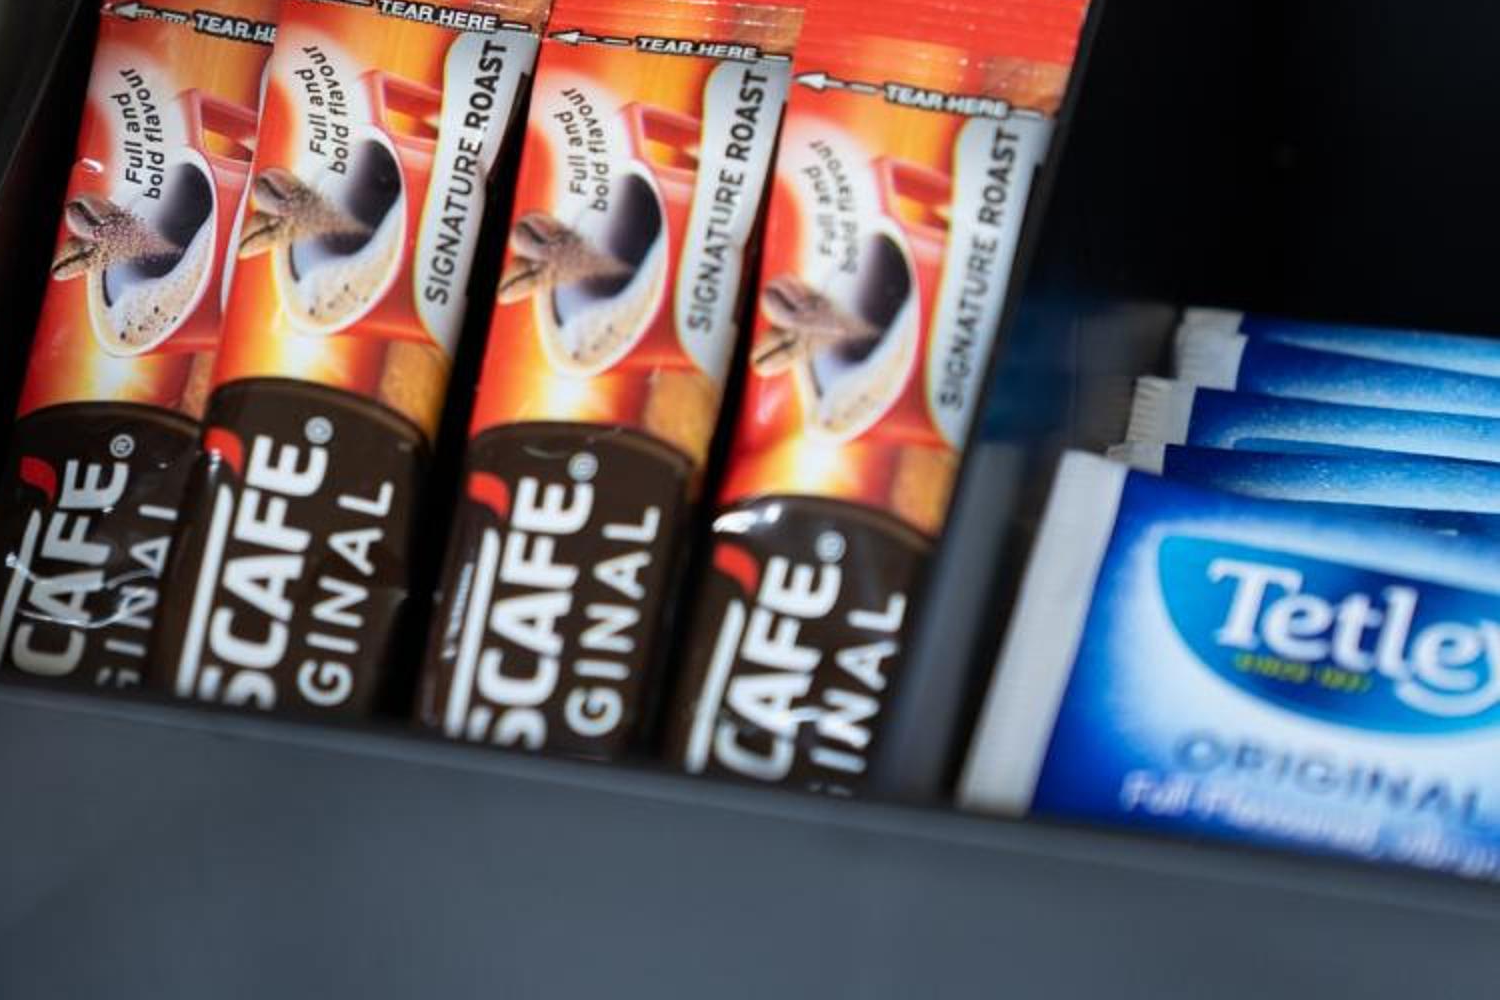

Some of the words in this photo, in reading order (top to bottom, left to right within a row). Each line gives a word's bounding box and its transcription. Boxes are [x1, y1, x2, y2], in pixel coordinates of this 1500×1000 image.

[195, 12, 249, 38] TEAR
[440, 9, 497, 32] HERE
[638, 37, 693, 56] TEAR
[698, 43, 757, 61] HERE
[119, 68, 163, 143] flavour
[294, 69, 324, 109] and
[302, 45, 347, 118] flavour
[887, 84, 942, 109] TEAR
[947, 96, 1008, 119] HERE
[110, 92, 141, 133] and
[308, 112, 328, 157] Full
[554, 110, 584, 148] and
[561, 87, 606, 155] flavour
[124, 141, 144, 185] Full
[329, 121, 349, 176] bold
[424, 137, 482, 306] SIGNATURE
[465, 40, 508, 130] ROAST
[143, 149, 165, 200] bold
[567, 154, 588, 196] Full
[589, 161, 609, 213] bold
[686, 167, 745, 334] SIGNATURE
[725, 70, 768, 162] ROAST
[939, 236, 998, 411] SIGNATURE
[978, 128, 1020, 227] ROAST
[806, 592, 907, 796] INAL
[1176, 733, 1481, 821] ORIGINAL
